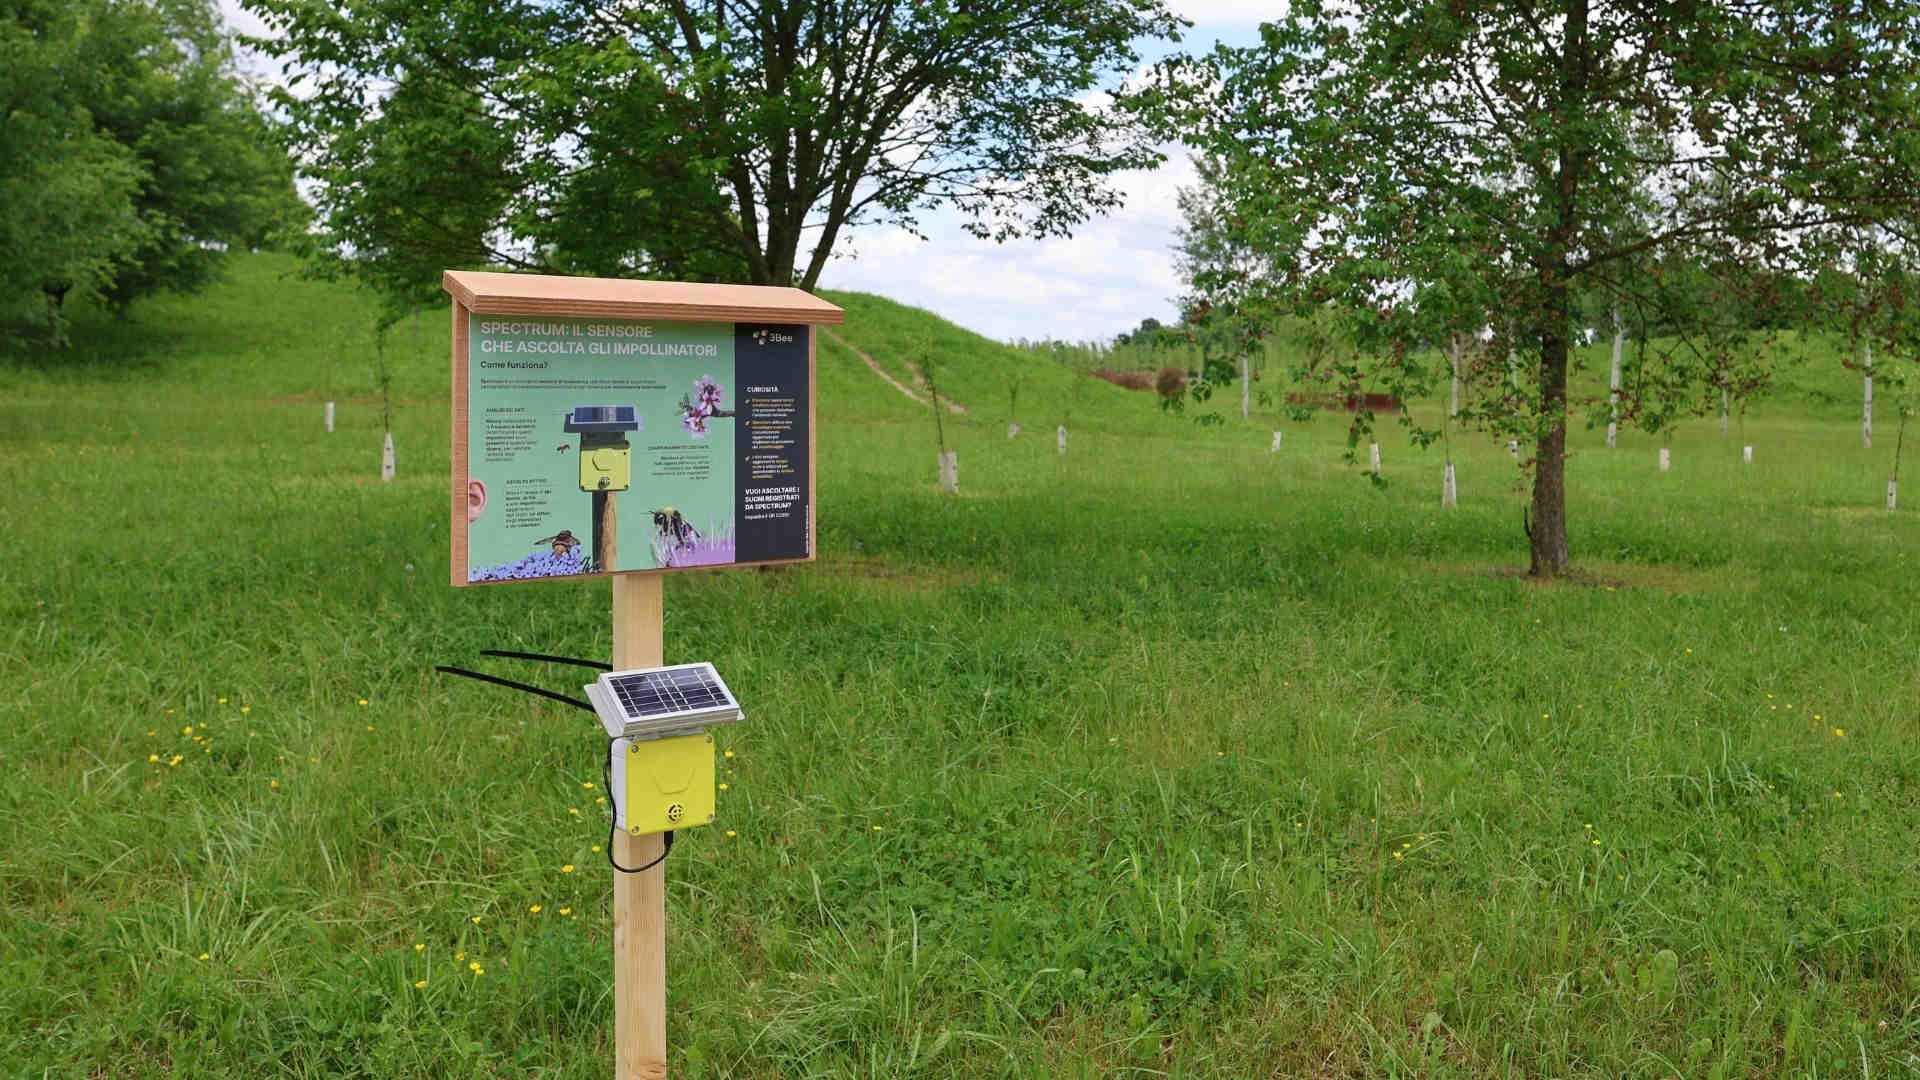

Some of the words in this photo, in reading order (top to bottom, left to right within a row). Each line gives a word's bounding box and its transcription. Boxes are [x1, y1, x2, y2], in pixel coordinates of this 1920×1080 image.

[481, 322, 569, 337] SPECTRUM:
[572, 325, 583, 337] IL
[586, 324, 654, 338] SENSORE
[481, 340, 513, 353] CHE
[516, 341, 585, 354] ASCOLTA
[588, 342, 611, 355] GLI
[613, 343, 718, 357] IMPOLLINATORI
[480, 361, 505, 369] Come
[507, 361, 548, 370] funziona?
